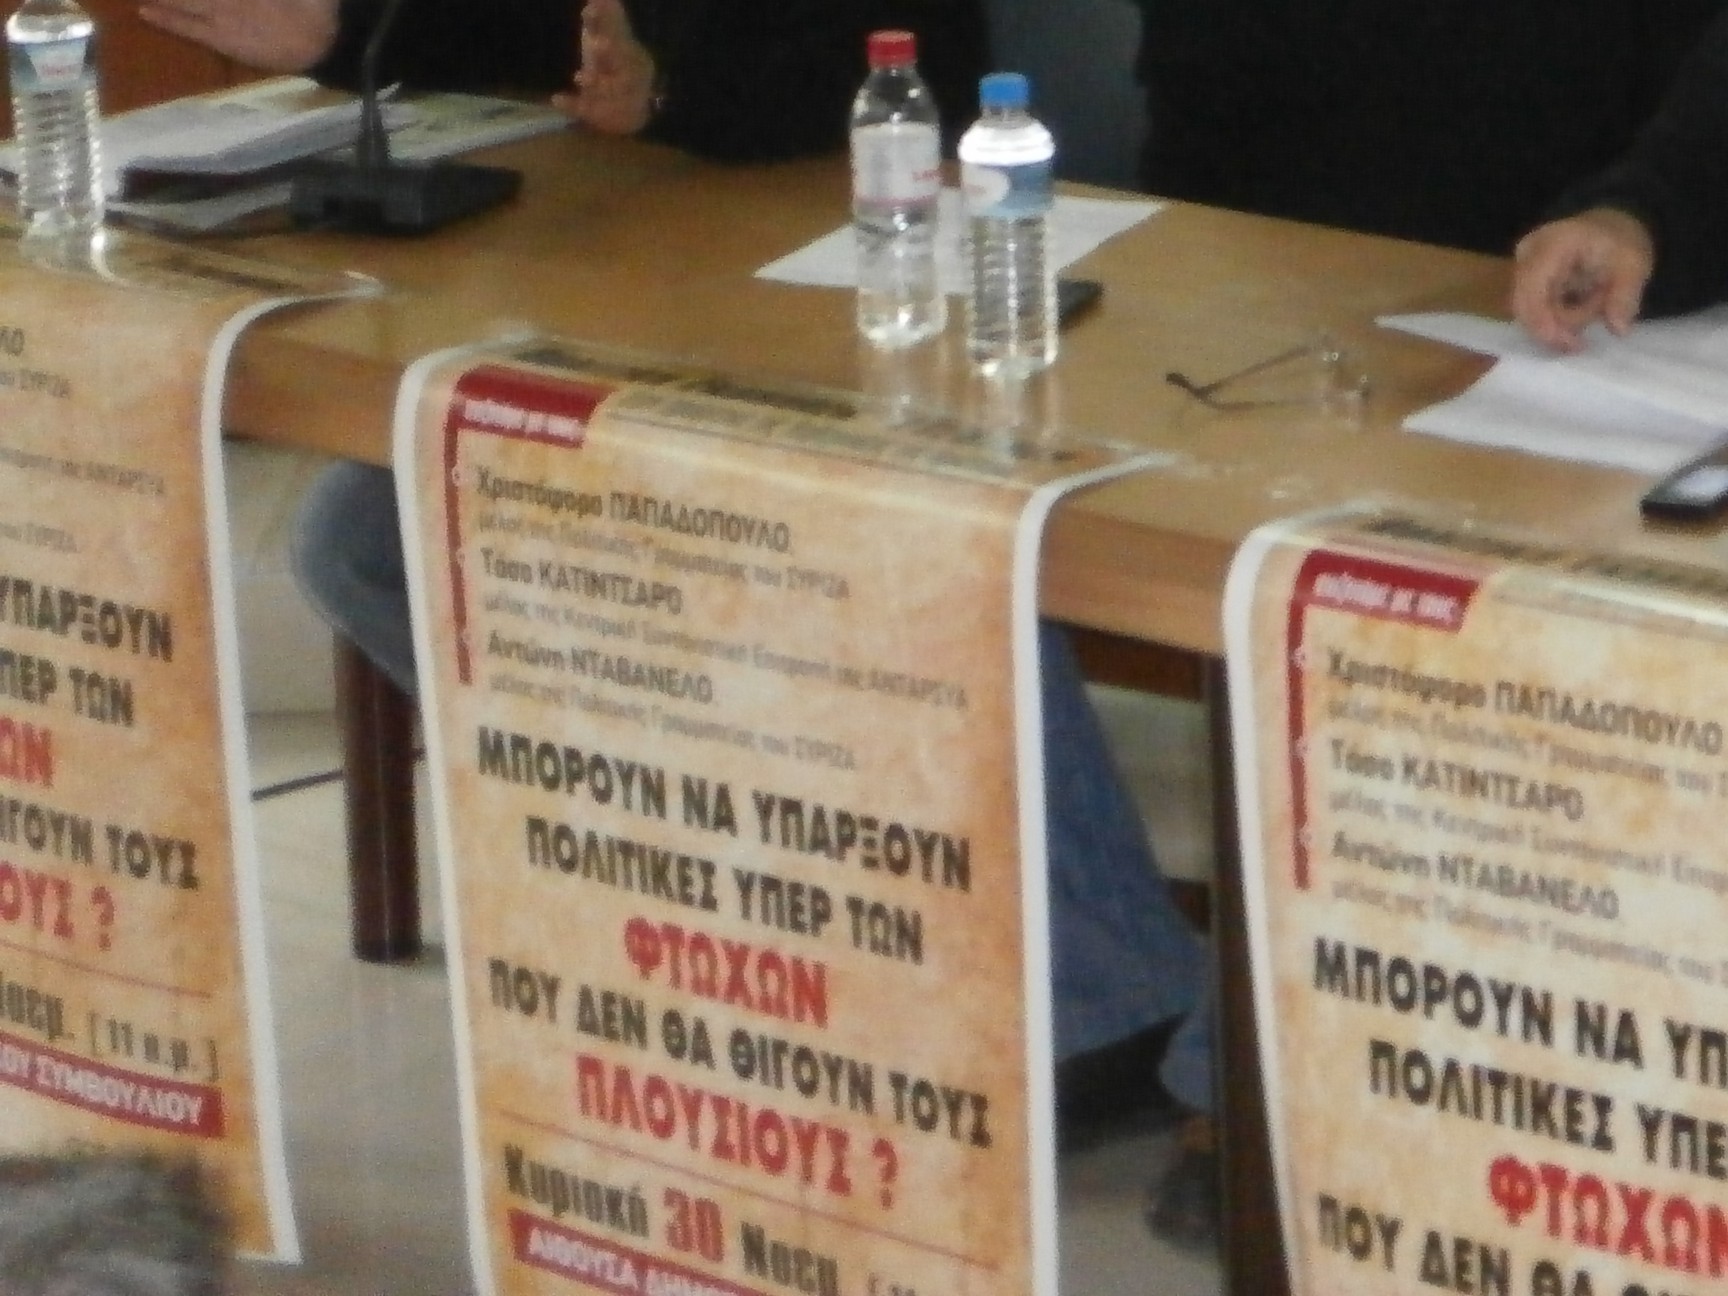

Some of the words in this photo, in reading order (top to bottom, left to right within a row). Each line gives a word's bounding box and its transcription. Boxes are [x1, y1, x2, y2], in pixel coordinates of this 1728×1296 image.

[68, 666, 135, 727] ΤΩΝ
[105, 823, 199, 890] ΤΟΥΣ
[478, 726, 666, 820] ΜΠΟΡΟΥΝ
[681, 773, 737, 838] ΝΑ
[751, 789, 971, 893] ΥΠΑΡΞΟΥΝ
[525, 815, 718, 912] ΠΟΛΙΤΙΚΕΣ
[733, 867, 832, 938] ΥΠΕΡ
[846, 894, 924, 966] ΤΩΝ
[623, 915, 829, 1030] ΦΤΩΧΩΝ
[1313, 935, 1554, 1051] ΜΠΟΡΟΥΝ
[1575, 998, 1643, 1070] ΝΑ
[488, 956, 563, 1023] ΠΟΥ
[575, 983, 648, 1052] ΔΕΝ
[660, 1008, 717, 1071] ΘΑ
[728, 1025, 875, 1116] ΘΙΓΟΥΝ
[887, 1069, 993, 1150] ΤΟΥΣ
[1368, 1037, 1614, 1153] ΠΟΛΙΤΙΚΕΣ
[574, 1053, 852, 1197] ΠΛΟΥΣΙΟΥΣ
[871, 1136, 900, 1210] ?
[663, 1185, 724, 1265] 30
[1317, 1191, 1403, 1273] ΠΟΥ
[1419, 1229, 1511, 1296] ΔΕΝ
